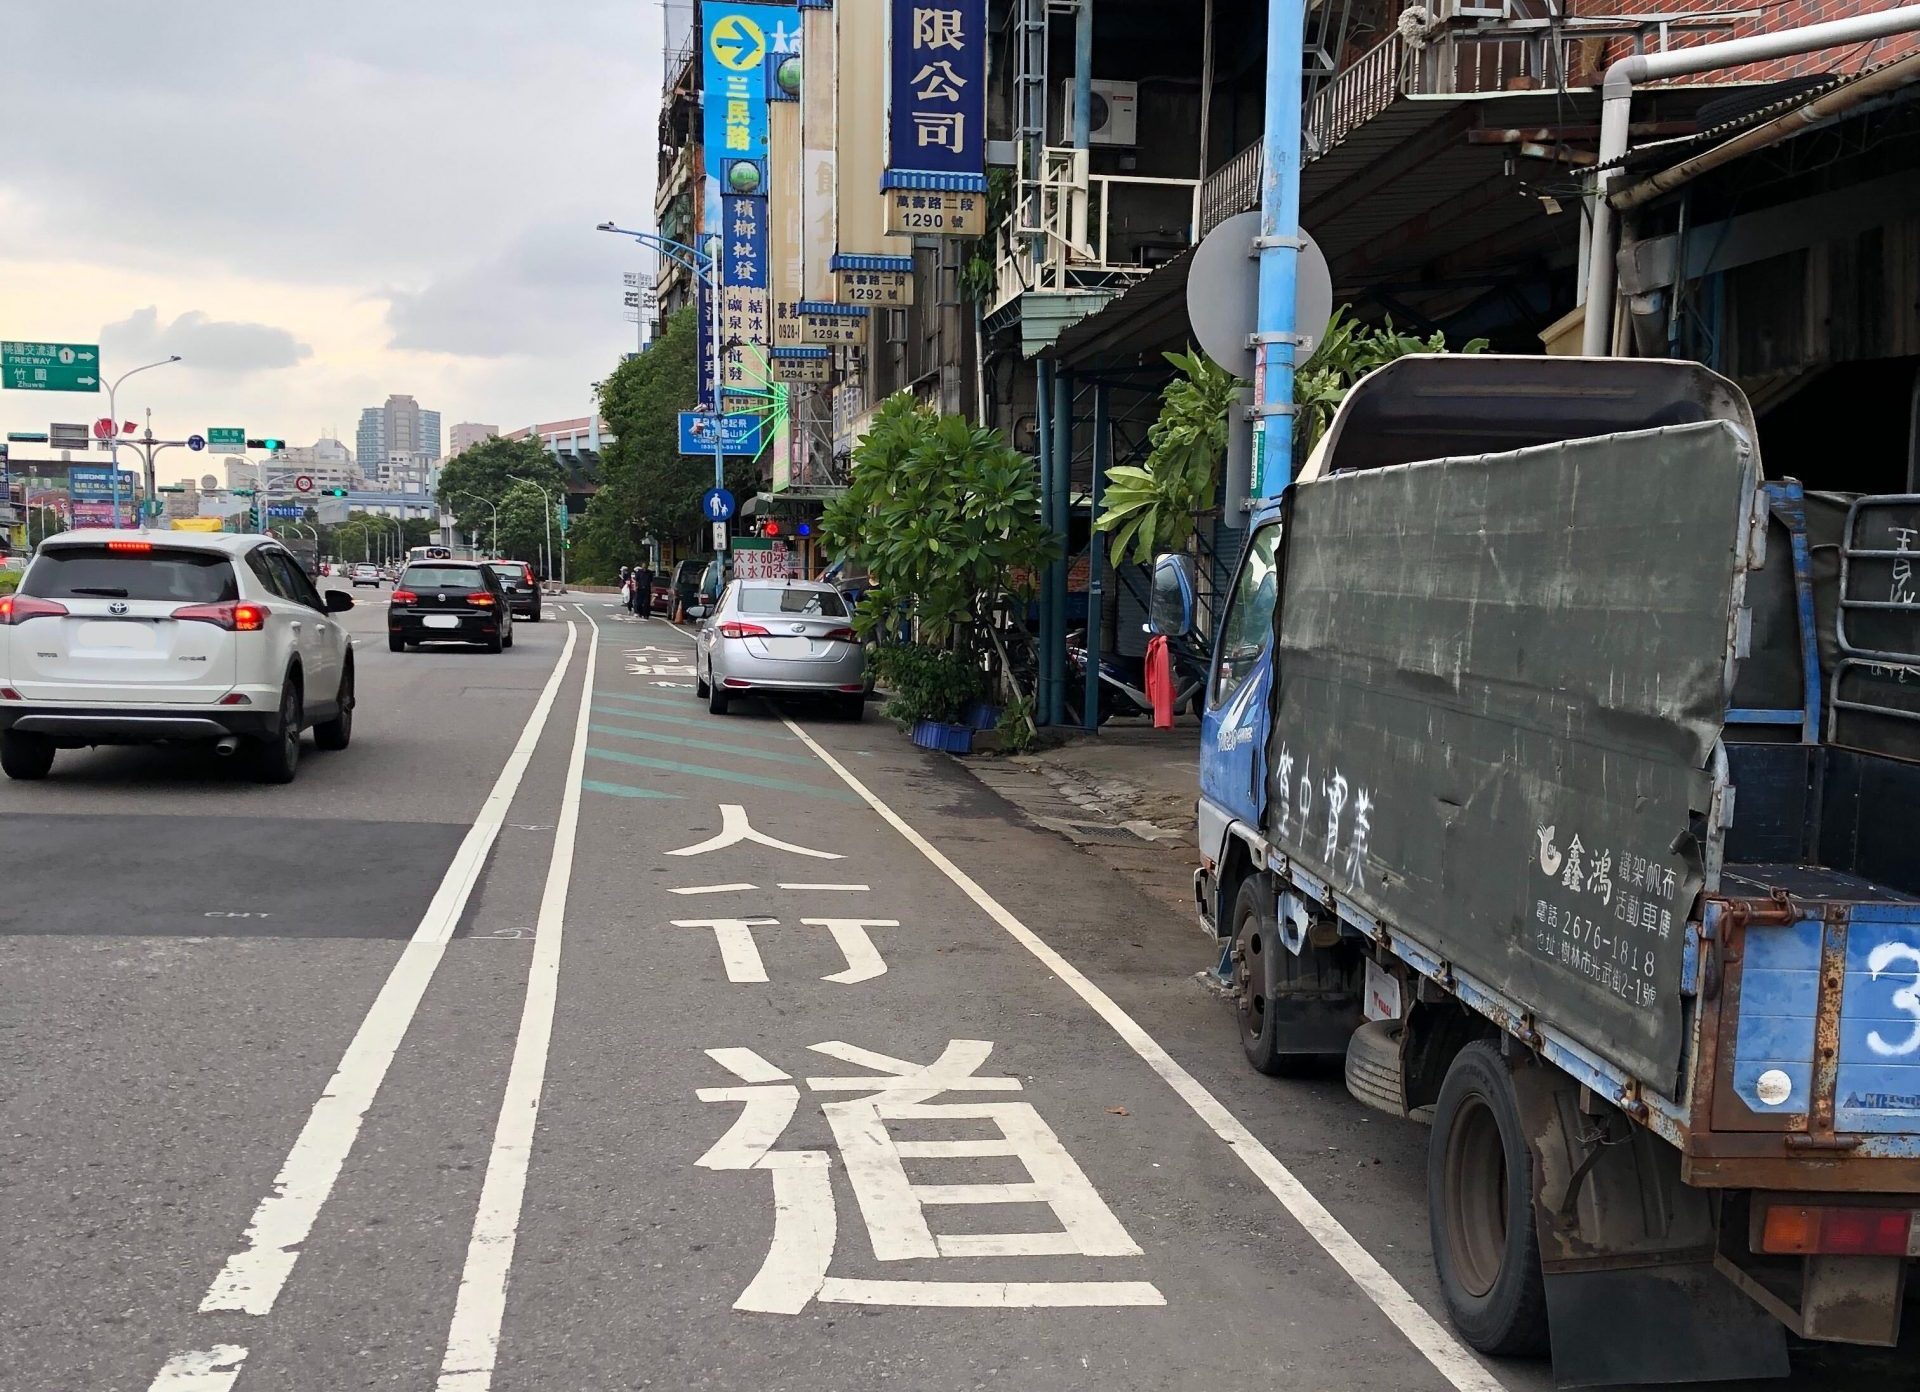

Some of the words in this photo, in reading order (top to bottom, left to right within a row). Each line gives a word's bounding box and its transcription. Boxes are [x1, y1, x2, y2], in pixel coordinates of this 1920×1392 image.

[910, 8, 967, 153] 限公司
[726, 76, 750, 151] 三民路
[896, 195, 973, 211] 萬壽路二段
[902, 213, 943, 228] 1290
[951, 215, 964, 228] 號
[843, 275, 905, 286] 萬壽路二段
[848, 289, 882, 300] 1292
[812, 330, 840, 339] 1294
[9, 356, 51, 365] FREEWAY
[761, 551, 772, 563] 60
[761, 565, 772, 578] 70
[1562, 832, 1612, 906] 鑫鴻
[1614, 888, 1672, 939] 活動車庫
[1536, 899, 1558, 928] 電話
[1562, 911, 1655, 977] 2676-1818
